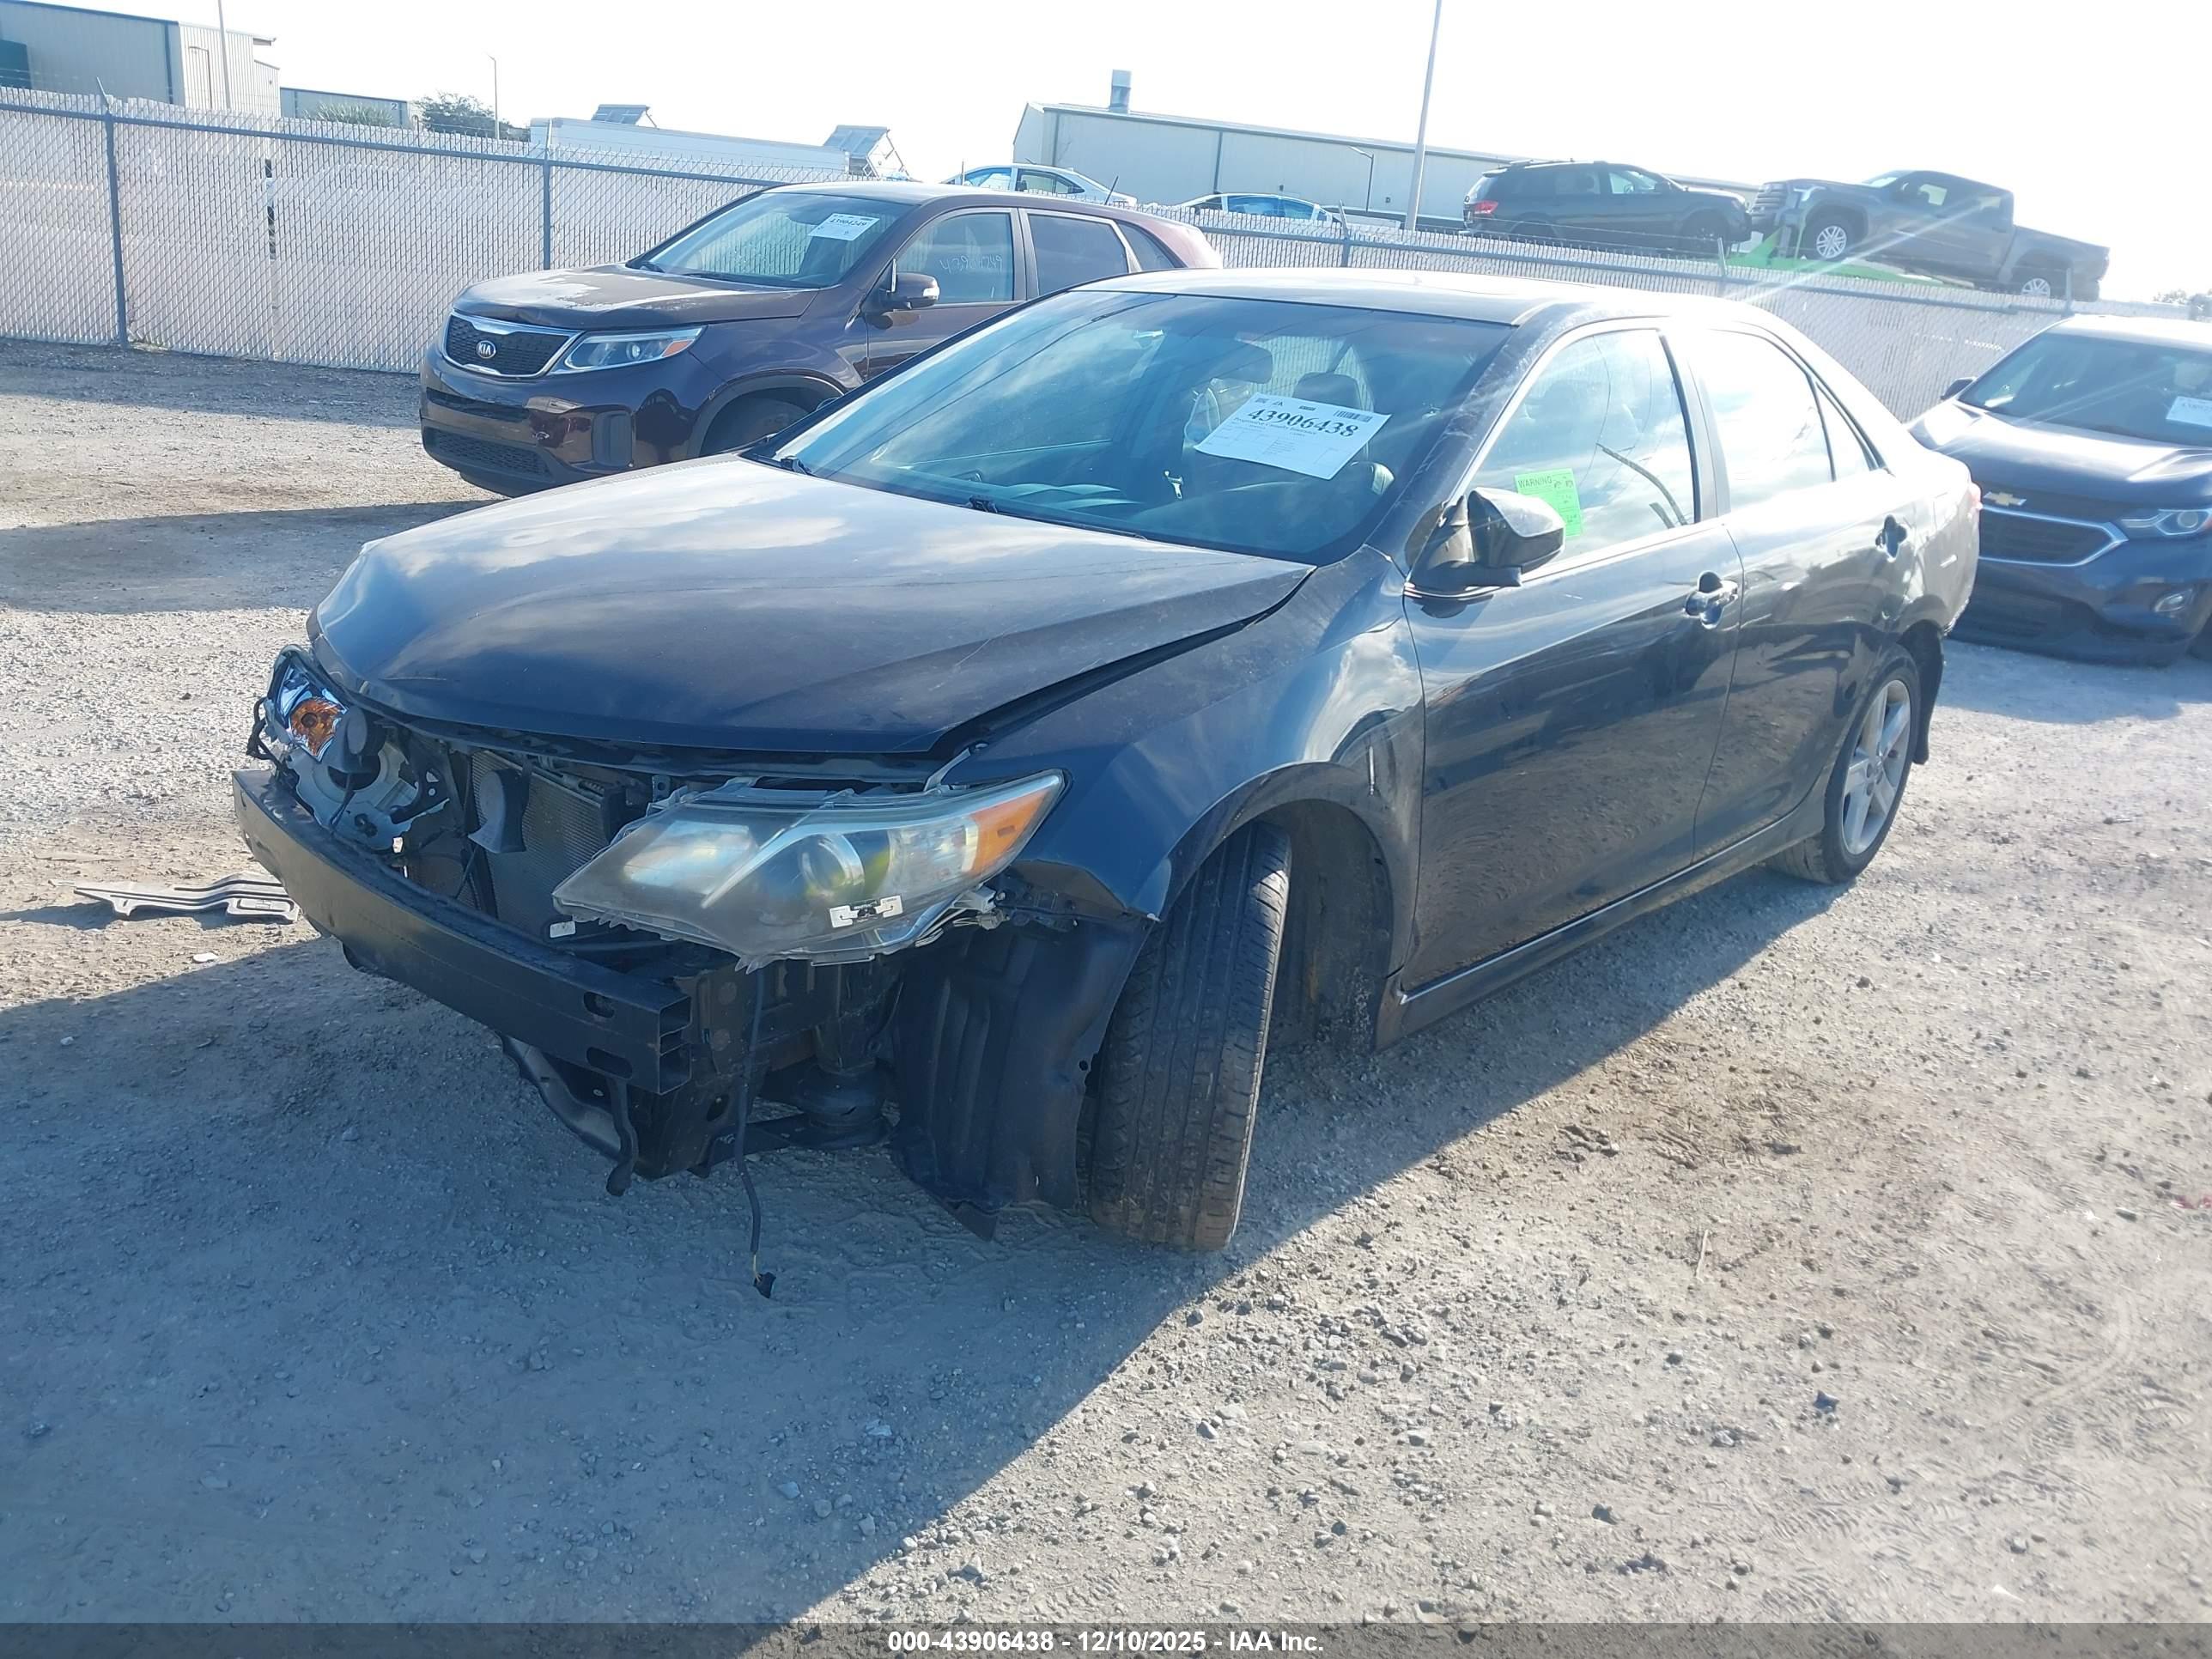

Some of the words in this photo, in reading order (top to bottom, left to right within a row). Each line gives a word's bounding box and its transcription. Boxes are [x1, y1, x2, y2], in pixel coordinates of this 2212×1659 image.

[477, 343, 492, 356] KIA
[1248, 409, 1358, 437] 43906438
[1517, 476, 1553, 489] WARNING
